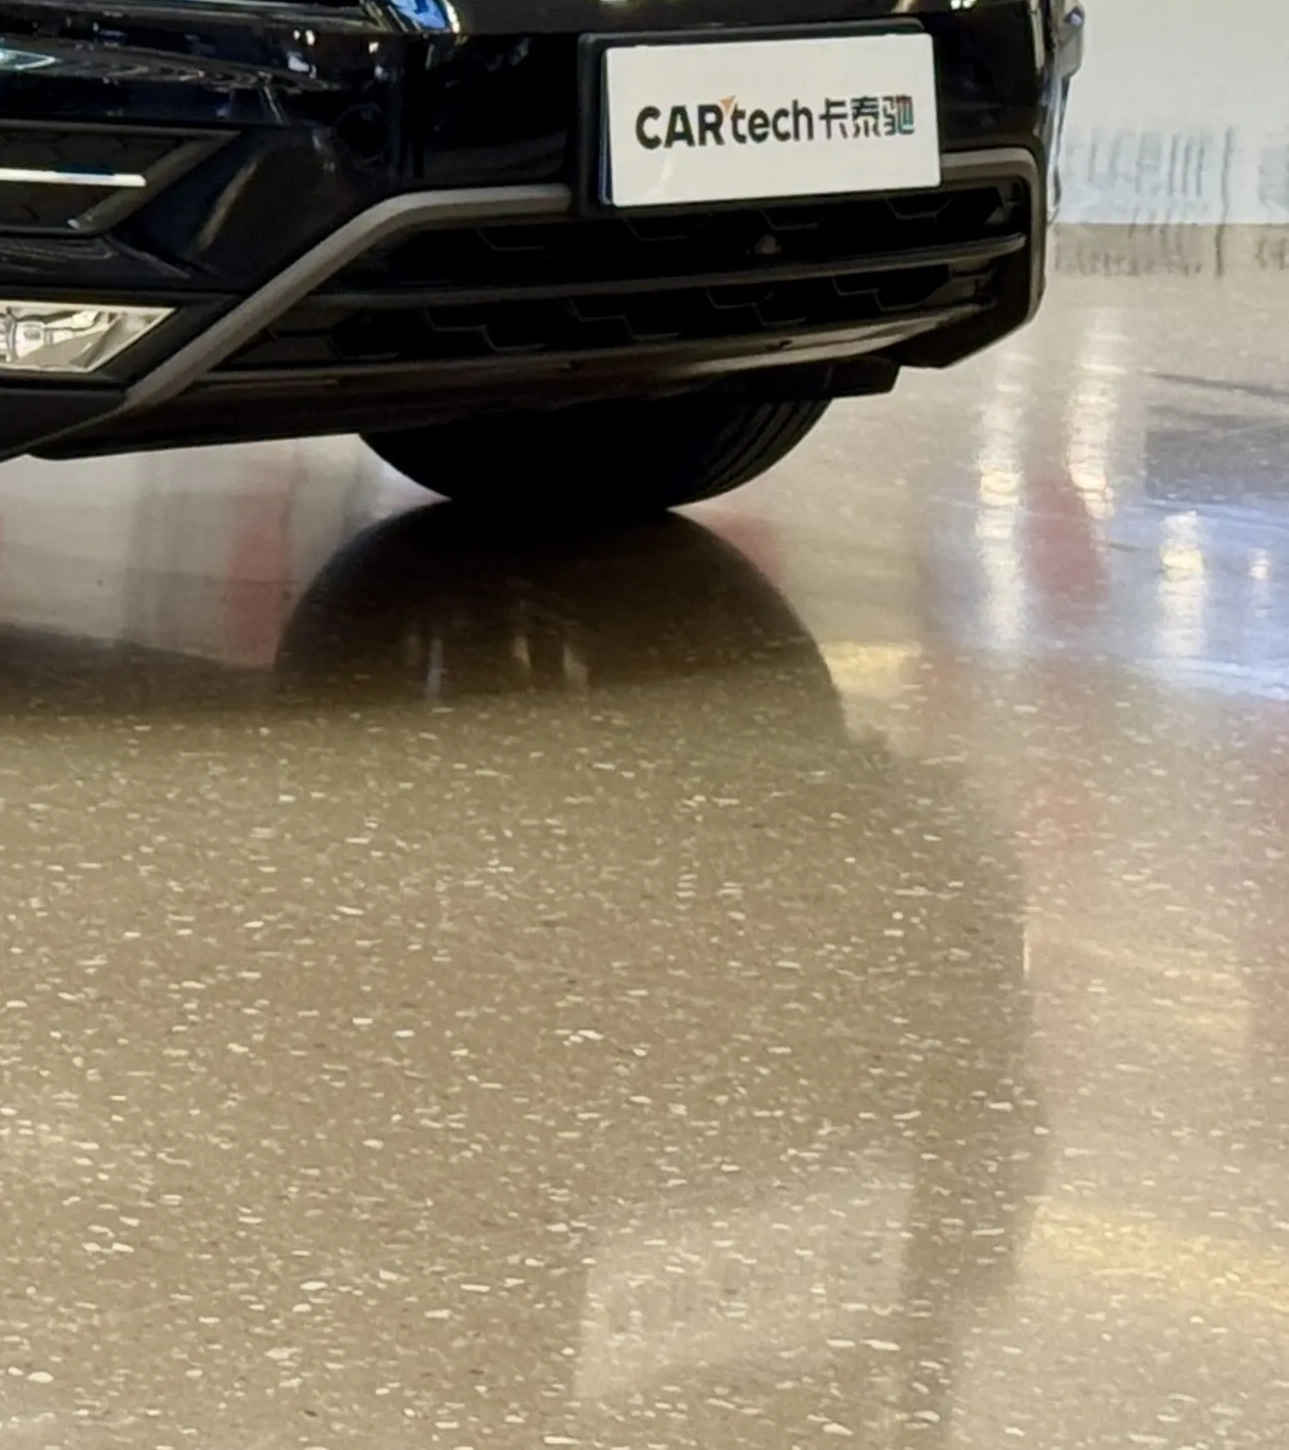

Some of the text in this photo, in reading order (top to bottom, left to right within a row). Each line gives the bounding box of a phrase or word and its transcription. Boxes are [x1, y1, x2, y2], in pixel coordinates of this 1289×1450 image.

[635, 94, 915, 150] CARtech 卡泰驰
